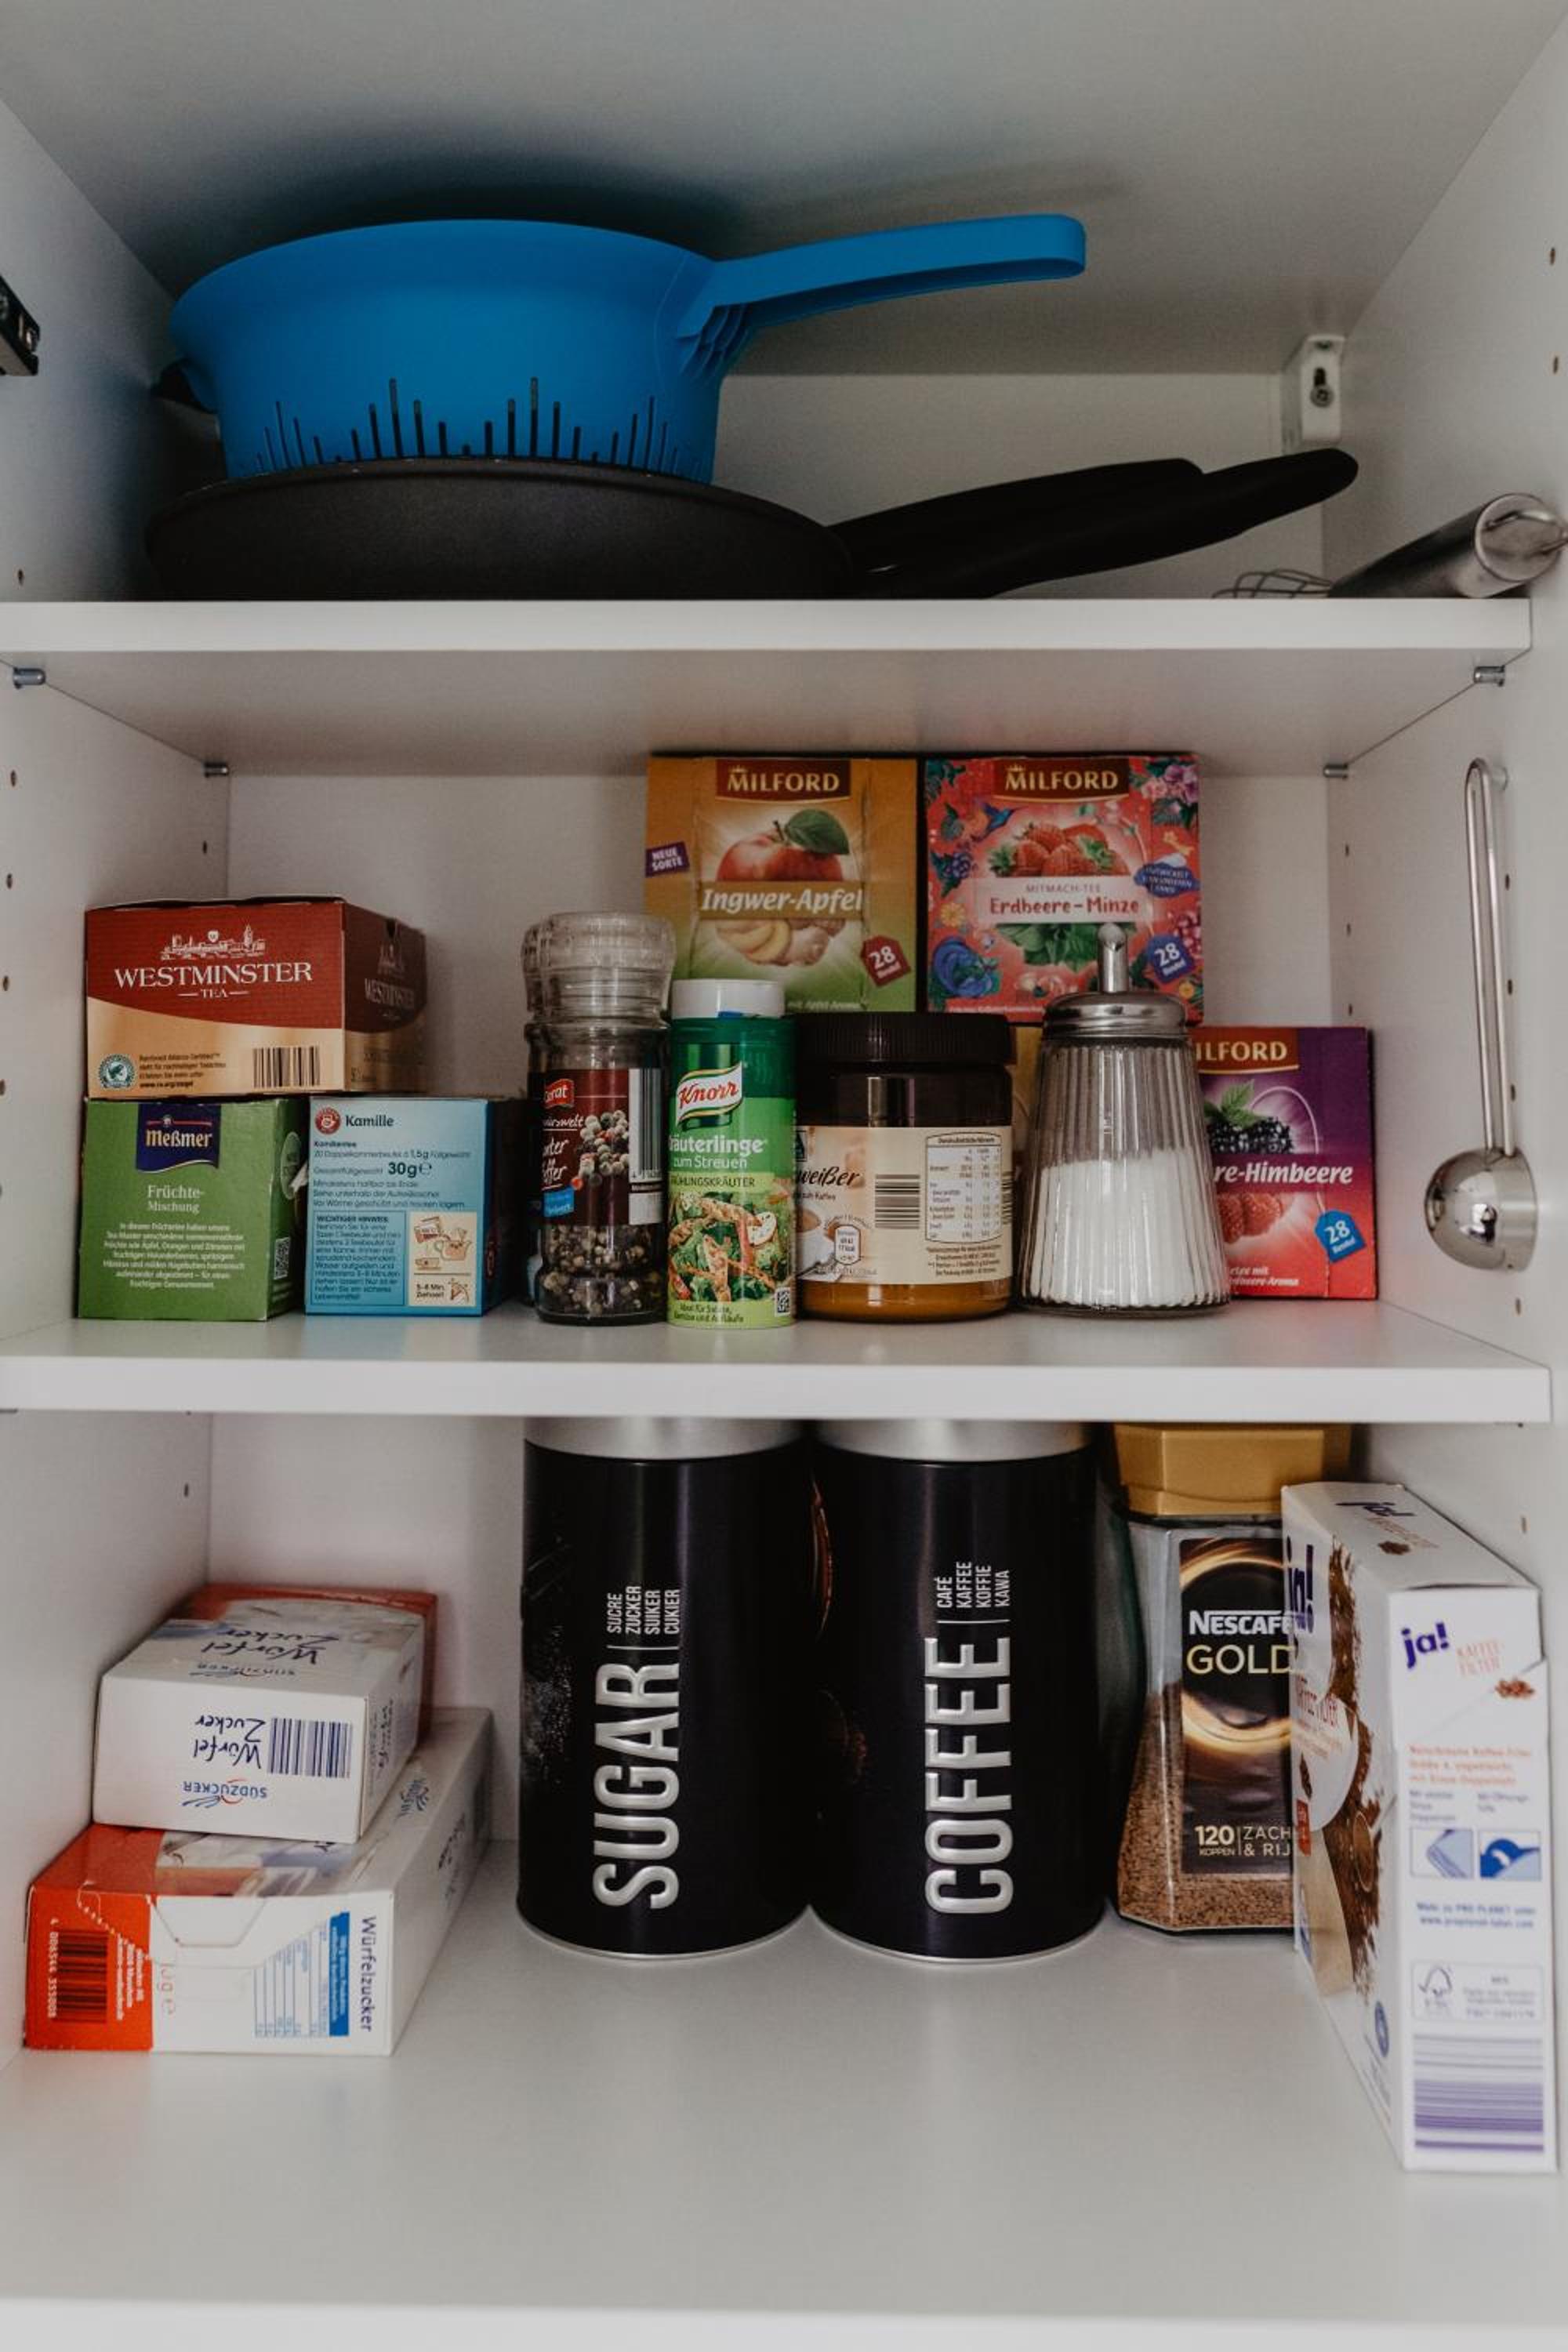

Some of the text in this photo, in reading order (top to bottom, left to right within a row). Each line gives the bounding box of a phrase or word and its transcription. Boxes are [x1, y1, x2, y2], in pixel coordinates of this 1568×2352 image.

[727, 771, 840, 793] MILFORD
[1005, 770, 1119, 791] MILFORD
[652, 856, 683, 871] SORTE
[701, 888, 863, 915] Ingwer-Apfel
[868, 946, 897, 971] 28
[1154, 942, 1181, 967] 28
[114, 961, 314, 989] WESTMINSTER
[200, 989, 229, 999] TEA
[1195, 1040, 1288, 1062] ILFORD
[677, 1080, 739, 1109] Knorr
[345, 1114, 394, 1127] Kamille
[146, 1128, 213, 1148] Meßmer
[694, 1156, 747, 1170] Streuen
[147, 1184, 204, 1200] Früchte-
[147, 1200, 201, 1214] Mischung
[1323, 1220, 1352, 1245] 28
[935, 1575, 953, 1609] CAFÉ
[956, 1561, 973, 1609] KAFFEE
[977, 1564, 992, 1609] KOFFIE
[994, 1569, 1010, 1607] KAWA
[607, 1592, 622, 1635] SUCRE
[625, 1584, 642, 1635] ZUCKER
[644, 1588, 660, 1635] SUIKER
[663, 1588, 680, 1635] CUKIER
[217, 1628, 339, 1651] Zucker
[1400, 1621, 1450, 1670] ja!
[201, 1642, 318, 1665] Würfel
[1186, 1644, 1293, 1675] GOLD
[194, 1715, 266, 1742] Zucker
[192, 1738, 262, 1770] Würfel
[592, 1661, 680, 1910] SUGAR
[924, 1636, 1014, 1915] COFFEE
[182, 1780, 268, 1799] SÜDZUCKER
[1194, 1824, 1235, 1846] 120
[1243, 1825, 1291, 1840] ZACH
[1199, 1847, 1236, 1857] KOPPEN
[1243, 1843, 1291, 1857] & RIJ
[360, 1916, 377, 2033] Würfelzucker
